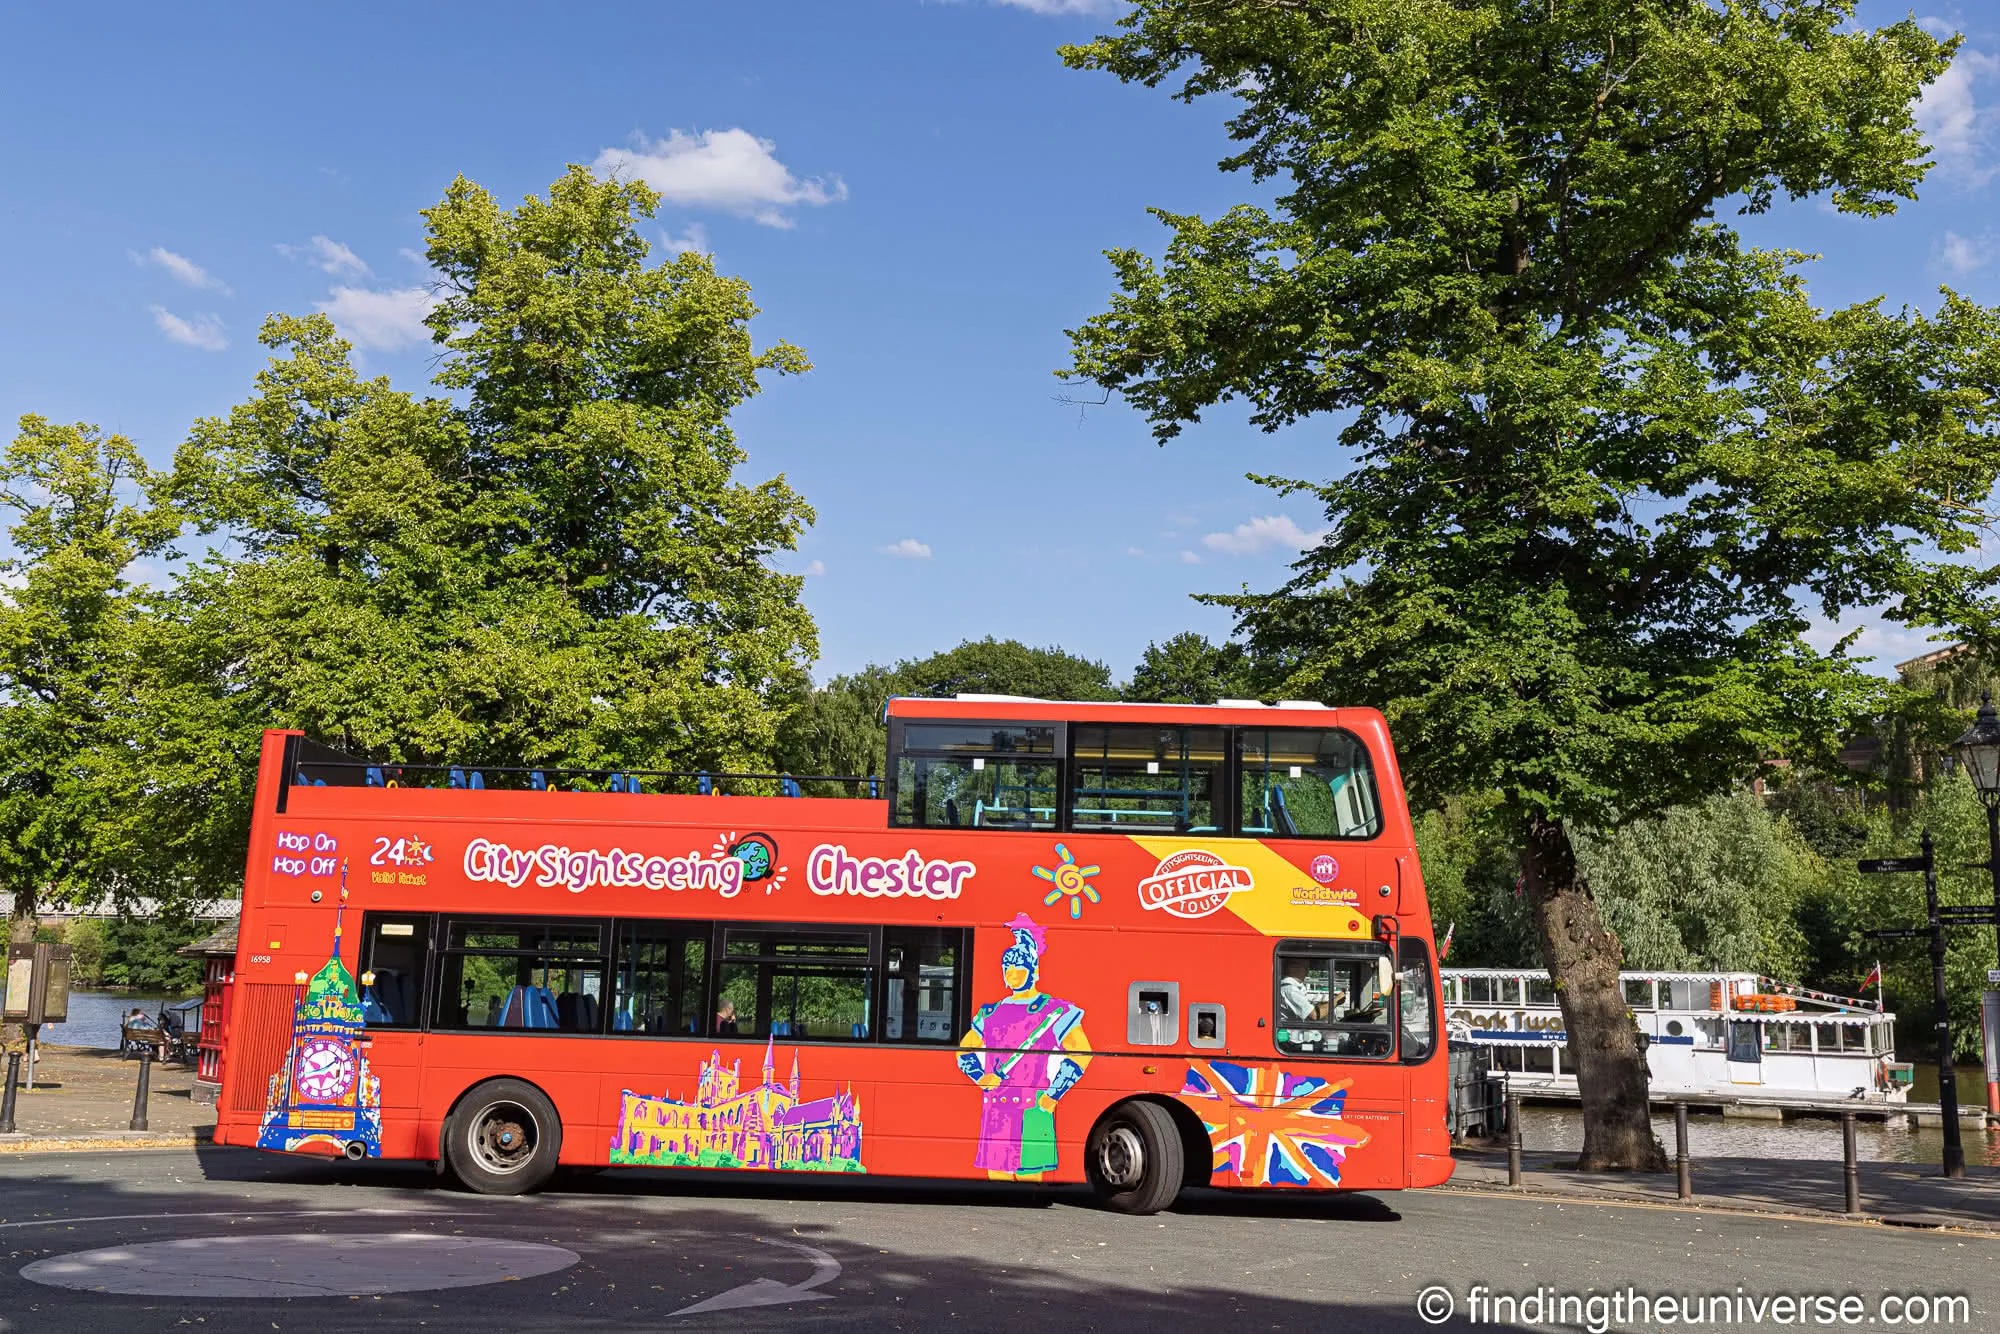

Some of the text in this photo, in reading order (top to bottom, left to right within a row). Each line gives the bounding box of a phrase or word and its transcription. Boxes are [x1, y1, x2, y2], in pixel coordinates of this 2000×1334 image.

[277, 831, 337, 852] Hop On
[370, 836, 406, 866] 24
[273, 856, 337, 876] Hop Off
[806, 843, 977, 900] Chester
[1161, 853, 1218, 874] CITYSIGHTSEEING
[1149, 871, 1245, 902] OFFICIAL
[1179, 894, 1222, 913] TOUR
[251, 955, 271, 964] 16958
[1450, 1009, 1567, 1032] Mark Twa
